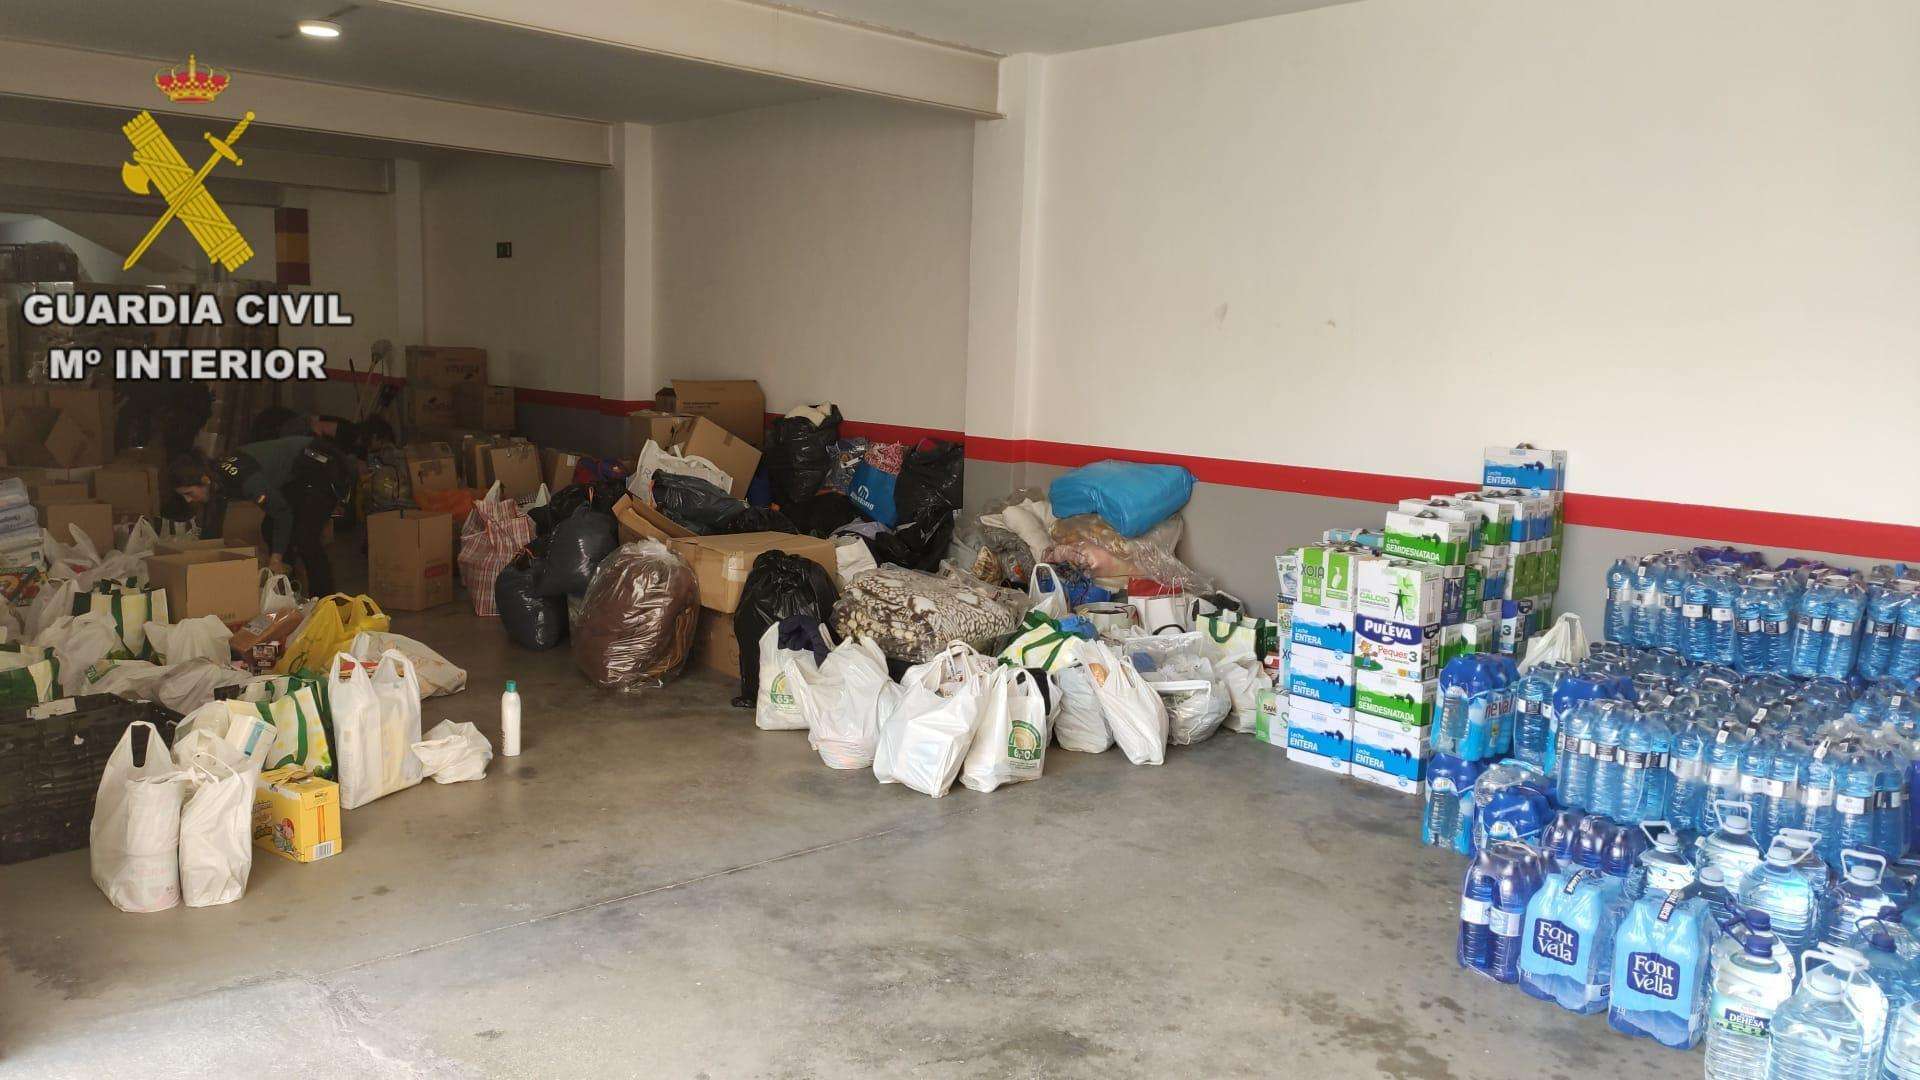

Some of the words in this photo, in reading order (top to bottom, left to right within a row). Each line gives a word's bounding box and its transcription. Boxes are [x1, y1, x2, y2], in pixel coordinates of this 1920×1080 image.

[1486, 475, 1517, 485] ENTERA
[1385, 543, 1440, 561] SEMIDESNATADA
[1363, 618, 1413, 641] PULEVA
[1294, 632, 1322, 646] ENTERA
[1292, 684, 1320, 699] ENTERA
[1358, 700, 1415, 722] SEMIDESNATADA
[1289, 737, 1318, 752] ENTERA
[1355, 753, 1385, 769] ENTERA
[1539, 921, 1574, 947] Font
[1537, 936, 1573, 963] Vella
[1633, 955, 1675, 981] Font
[1632, 971, 1674, 997] Vella
[1729, 1012, 1765, 1029] DEHESA
